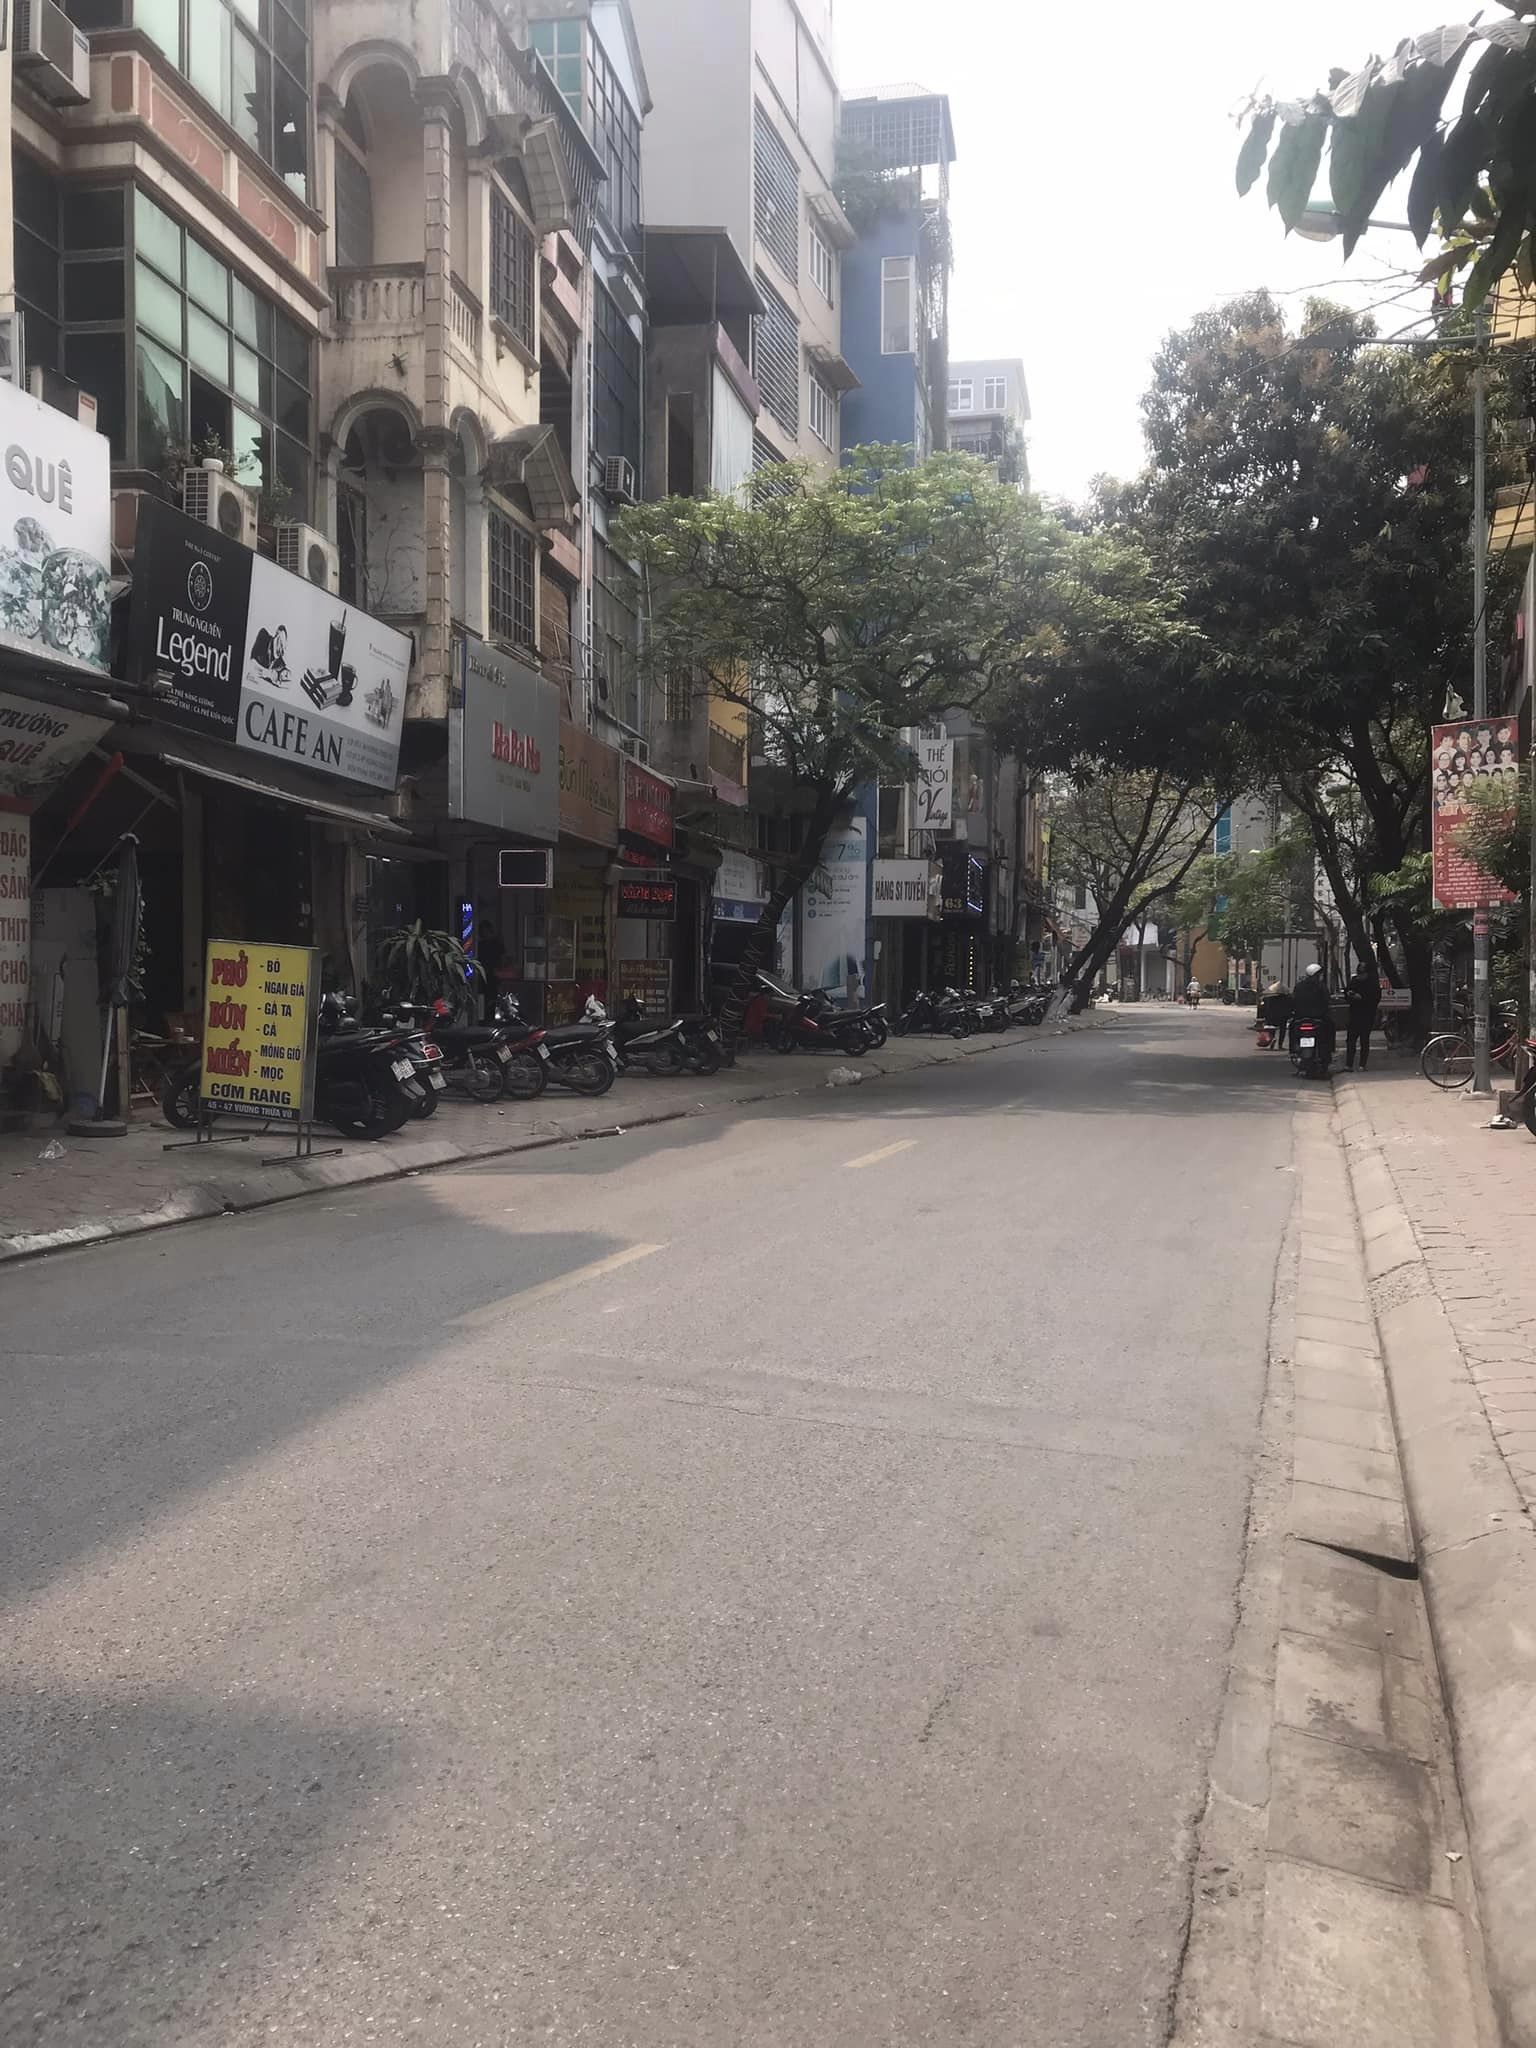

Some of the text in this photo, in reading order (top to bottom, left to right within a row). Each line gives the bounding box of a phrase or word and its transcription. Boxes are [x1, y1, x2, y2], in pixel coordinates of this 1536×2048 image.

[4, 443, 73, 515] QUÊ
[156, 615, 233, 682] Legend
[245, 700, 309, 756] CAFE
[311, 728, 344, 767] AN
[926, 743, 948, 763] THẾ
[211, 949, 248, 988] PHỞ
[264, 981, 288, 995] NGAN
[281, 1003, 292, 1017] TA
[206, 1037, 251, 1078] MIẾN
[260, 1065, 284, 1082] MỌC
[211, 1082, 292, 1105] CƠM RANG
